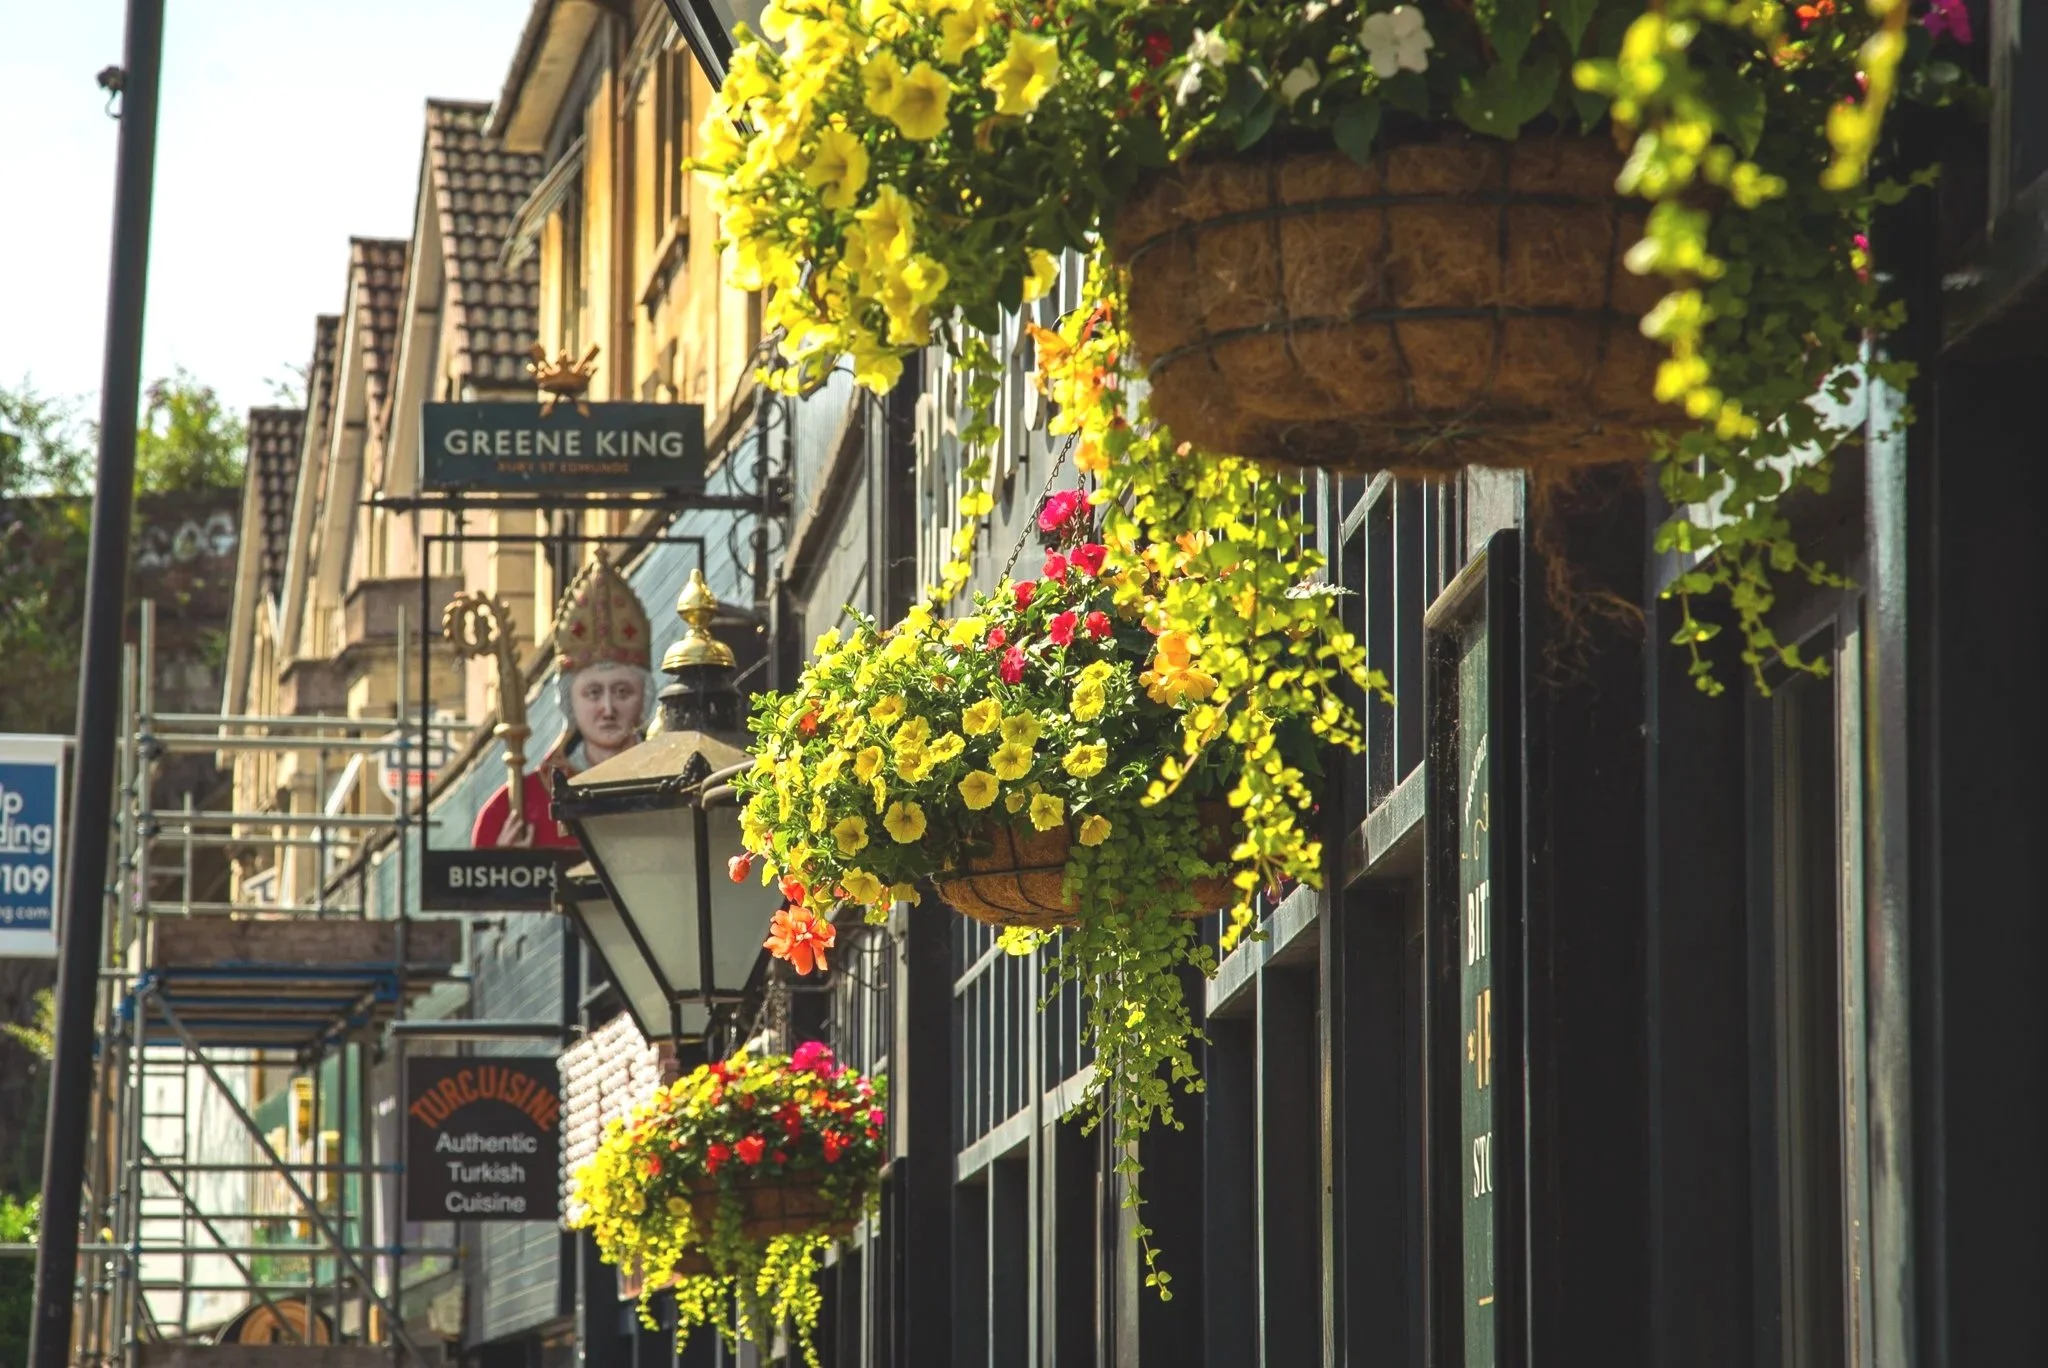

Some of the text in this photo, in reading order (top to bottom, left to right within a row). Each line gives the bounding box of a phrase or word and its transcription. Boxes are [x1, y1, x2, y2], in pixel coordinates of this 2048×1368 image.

[444, 429, 684, 457] GREENE KING
[0, 864, 50, 895] 109
[409, 1065, 560, 1133] TURCUISINE
[435, 1131, 538, 1154] Authentic
[446, 1160, 526, 1184] Turkish
[445, 1191, 527, 1214] Cuisine
